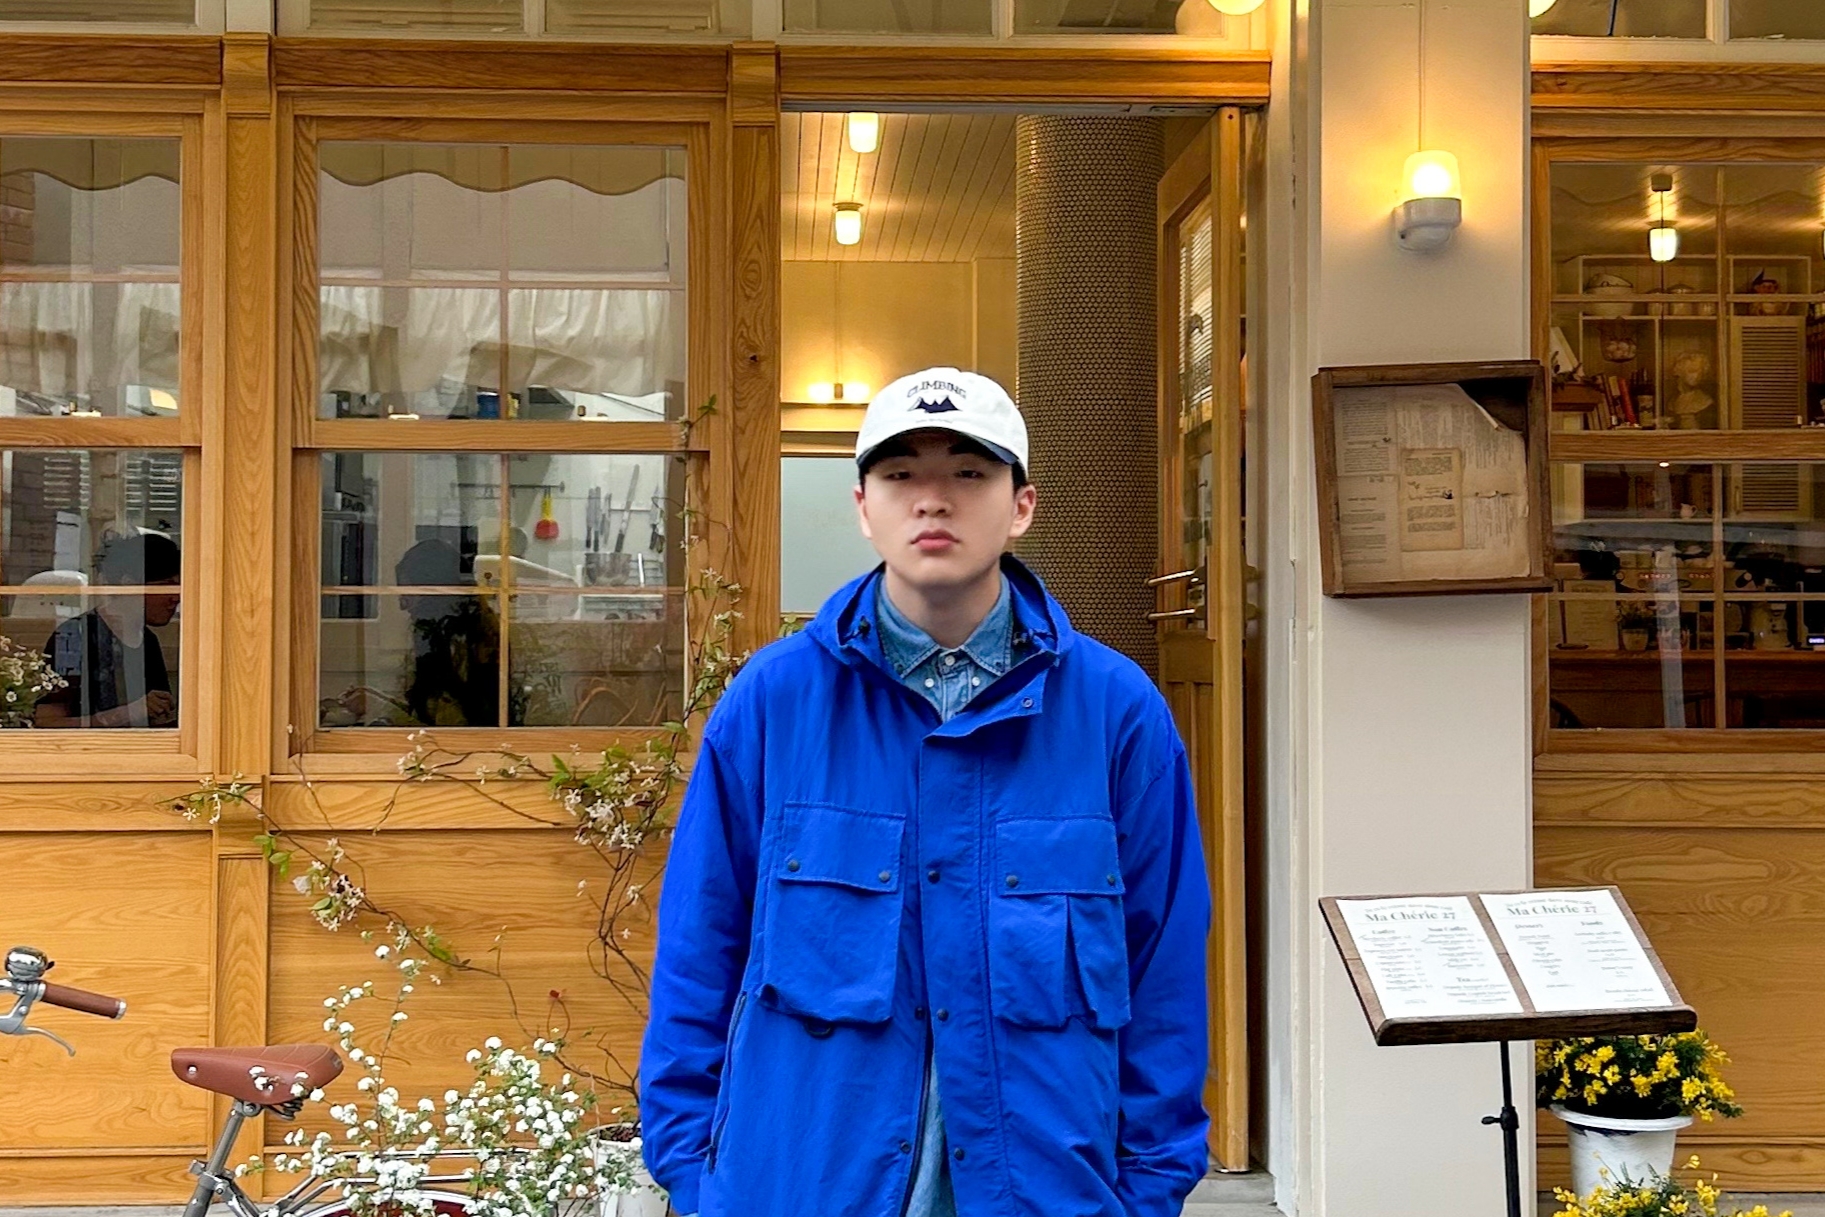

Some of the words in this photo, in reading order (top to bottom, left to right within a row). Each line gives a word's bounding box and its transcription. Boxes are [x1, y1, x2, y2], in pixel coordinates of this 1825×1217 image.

[907, 380, 967, 399] CLIMBING
[1364, 913, 1388, 922] Ma
[1390, 909, 1439, 921] Chérie
[1442, 911, 1456, 920] 27
[1506, 907, 1530, 916] Ma
[1532, 904, 1580, 915] Chérie
[1583, 906, 1598, 914] 27
